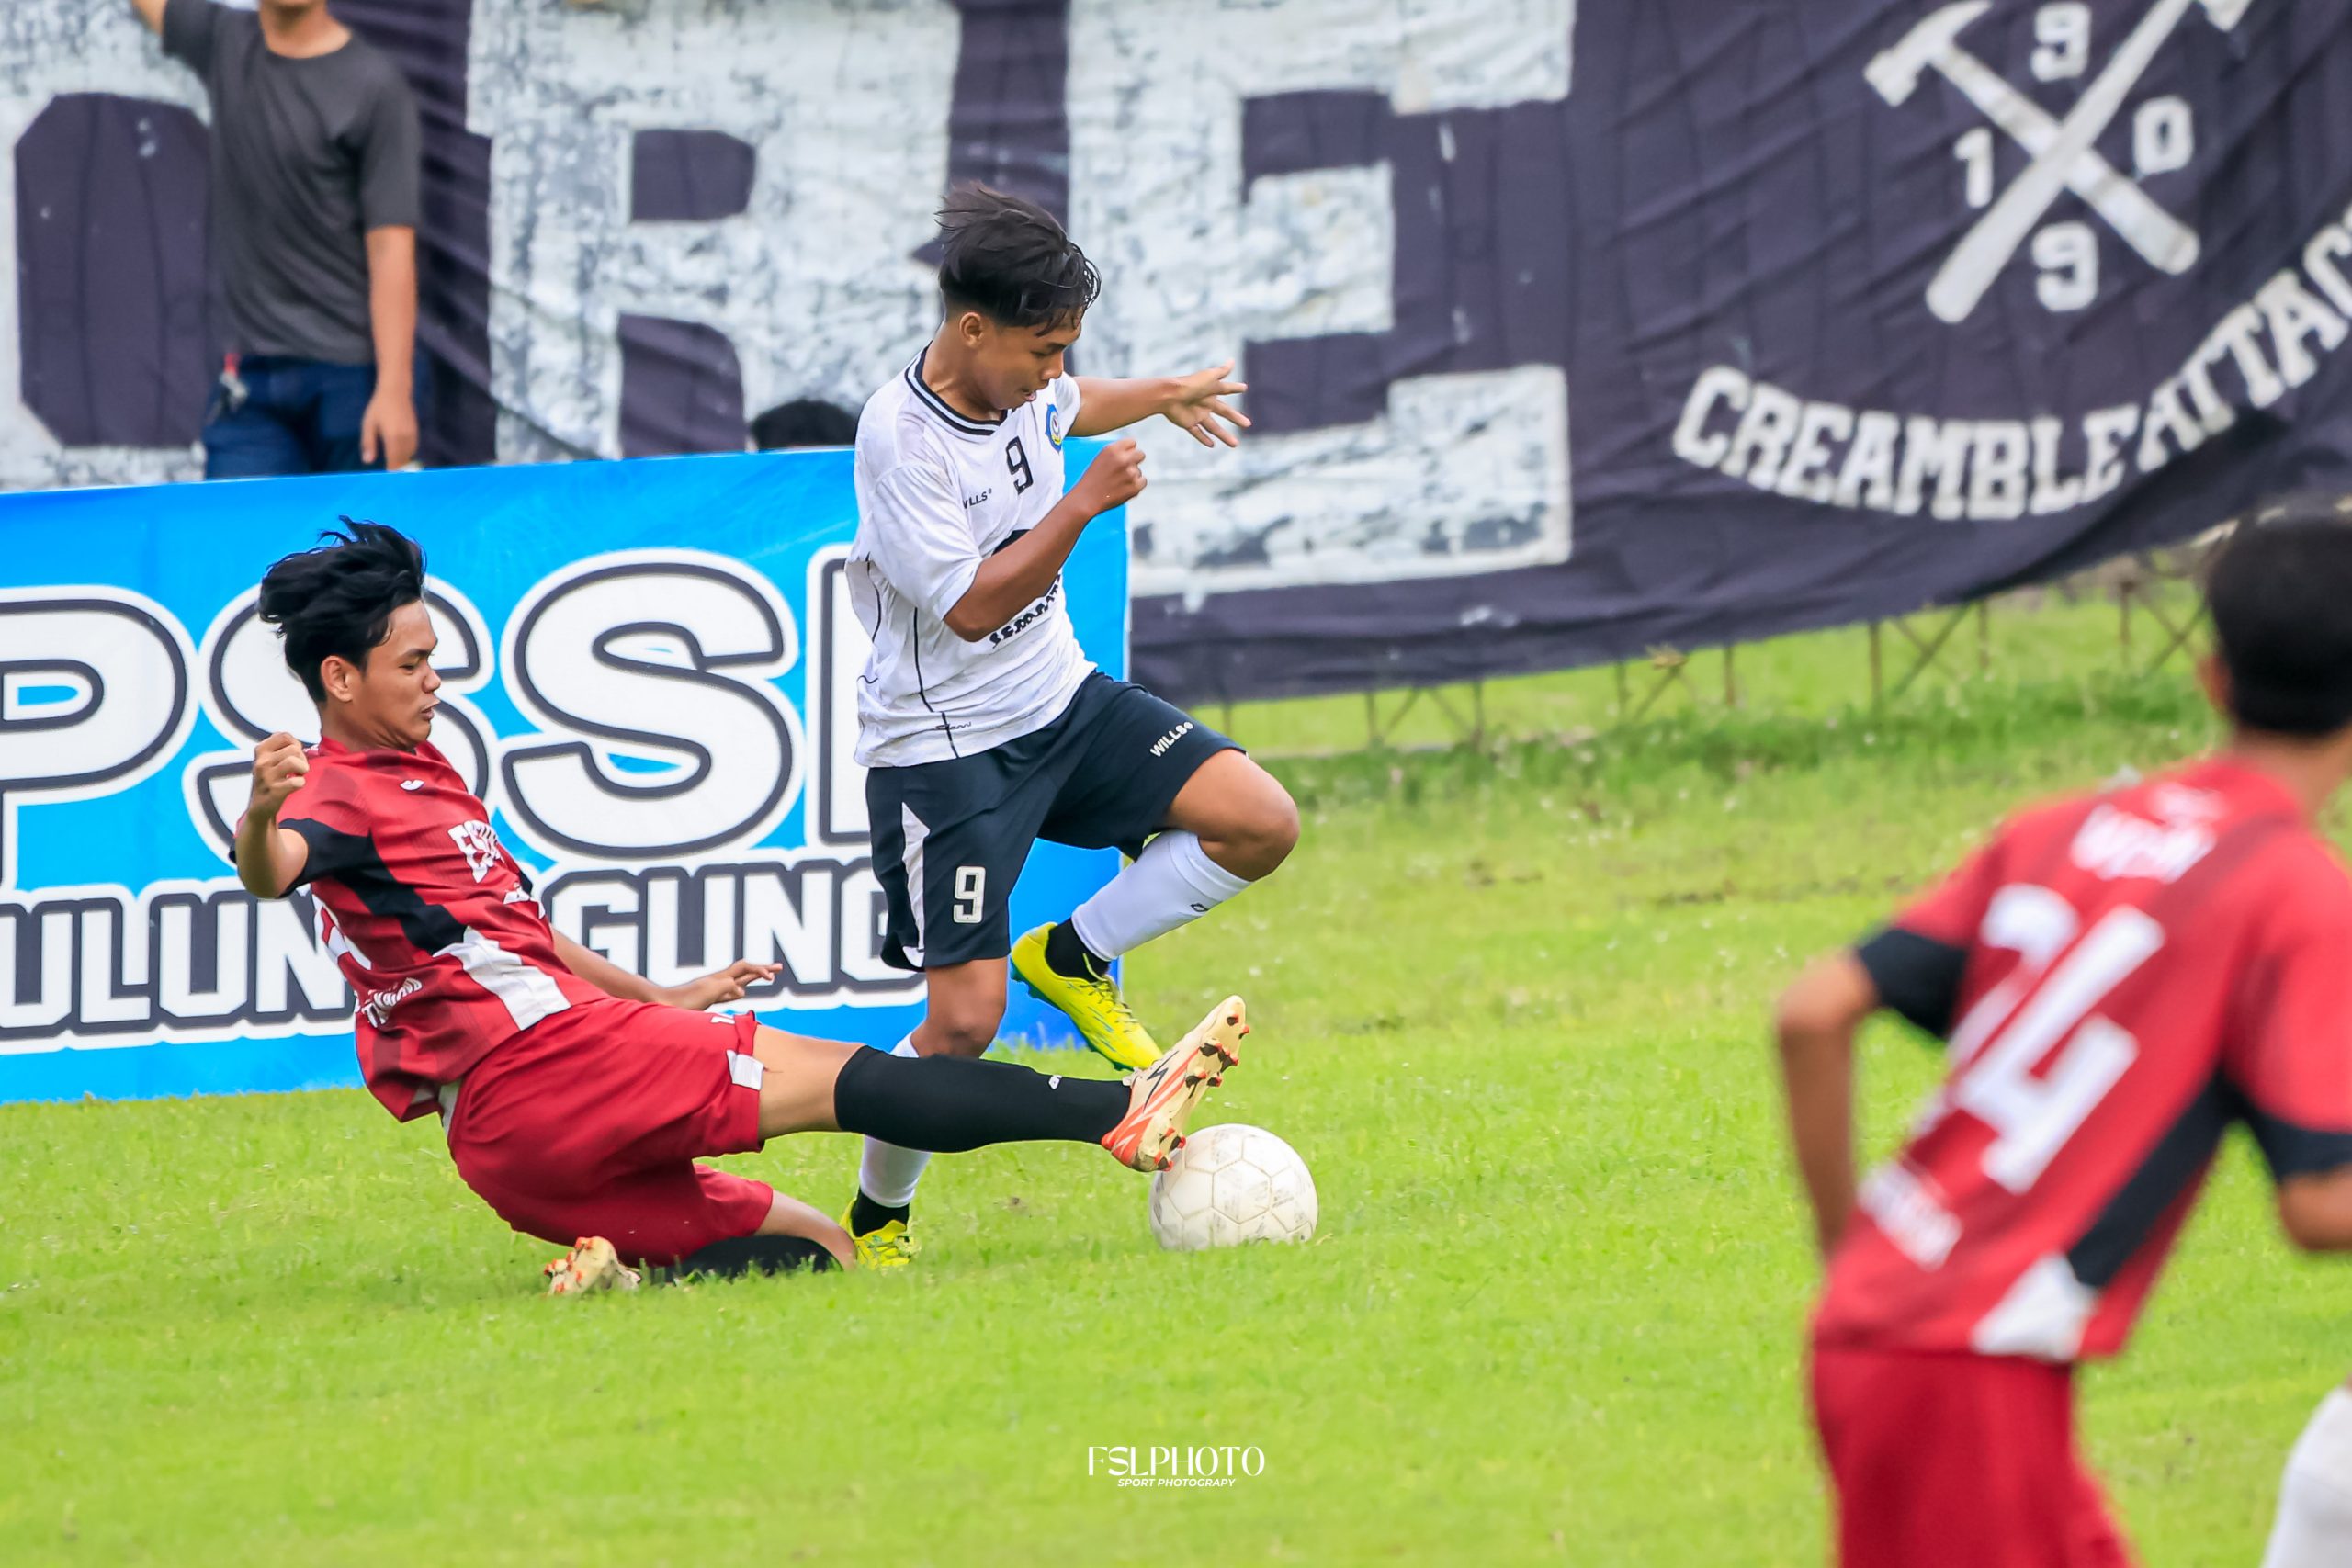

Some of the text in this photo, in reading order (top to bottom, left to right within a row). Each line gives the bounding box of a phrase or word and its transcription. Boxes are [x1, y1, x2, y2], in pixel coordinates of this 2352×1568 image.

[2030, 2, 2092, 81] 9
[1954, 127, 1994, 209] 1
[2030, 221, 2098, 313] 9
[2137, 200, 2352, 472] ATTAC
[1005, 435, 1034, 496] 9
[953, 865, 986, 924] 9
